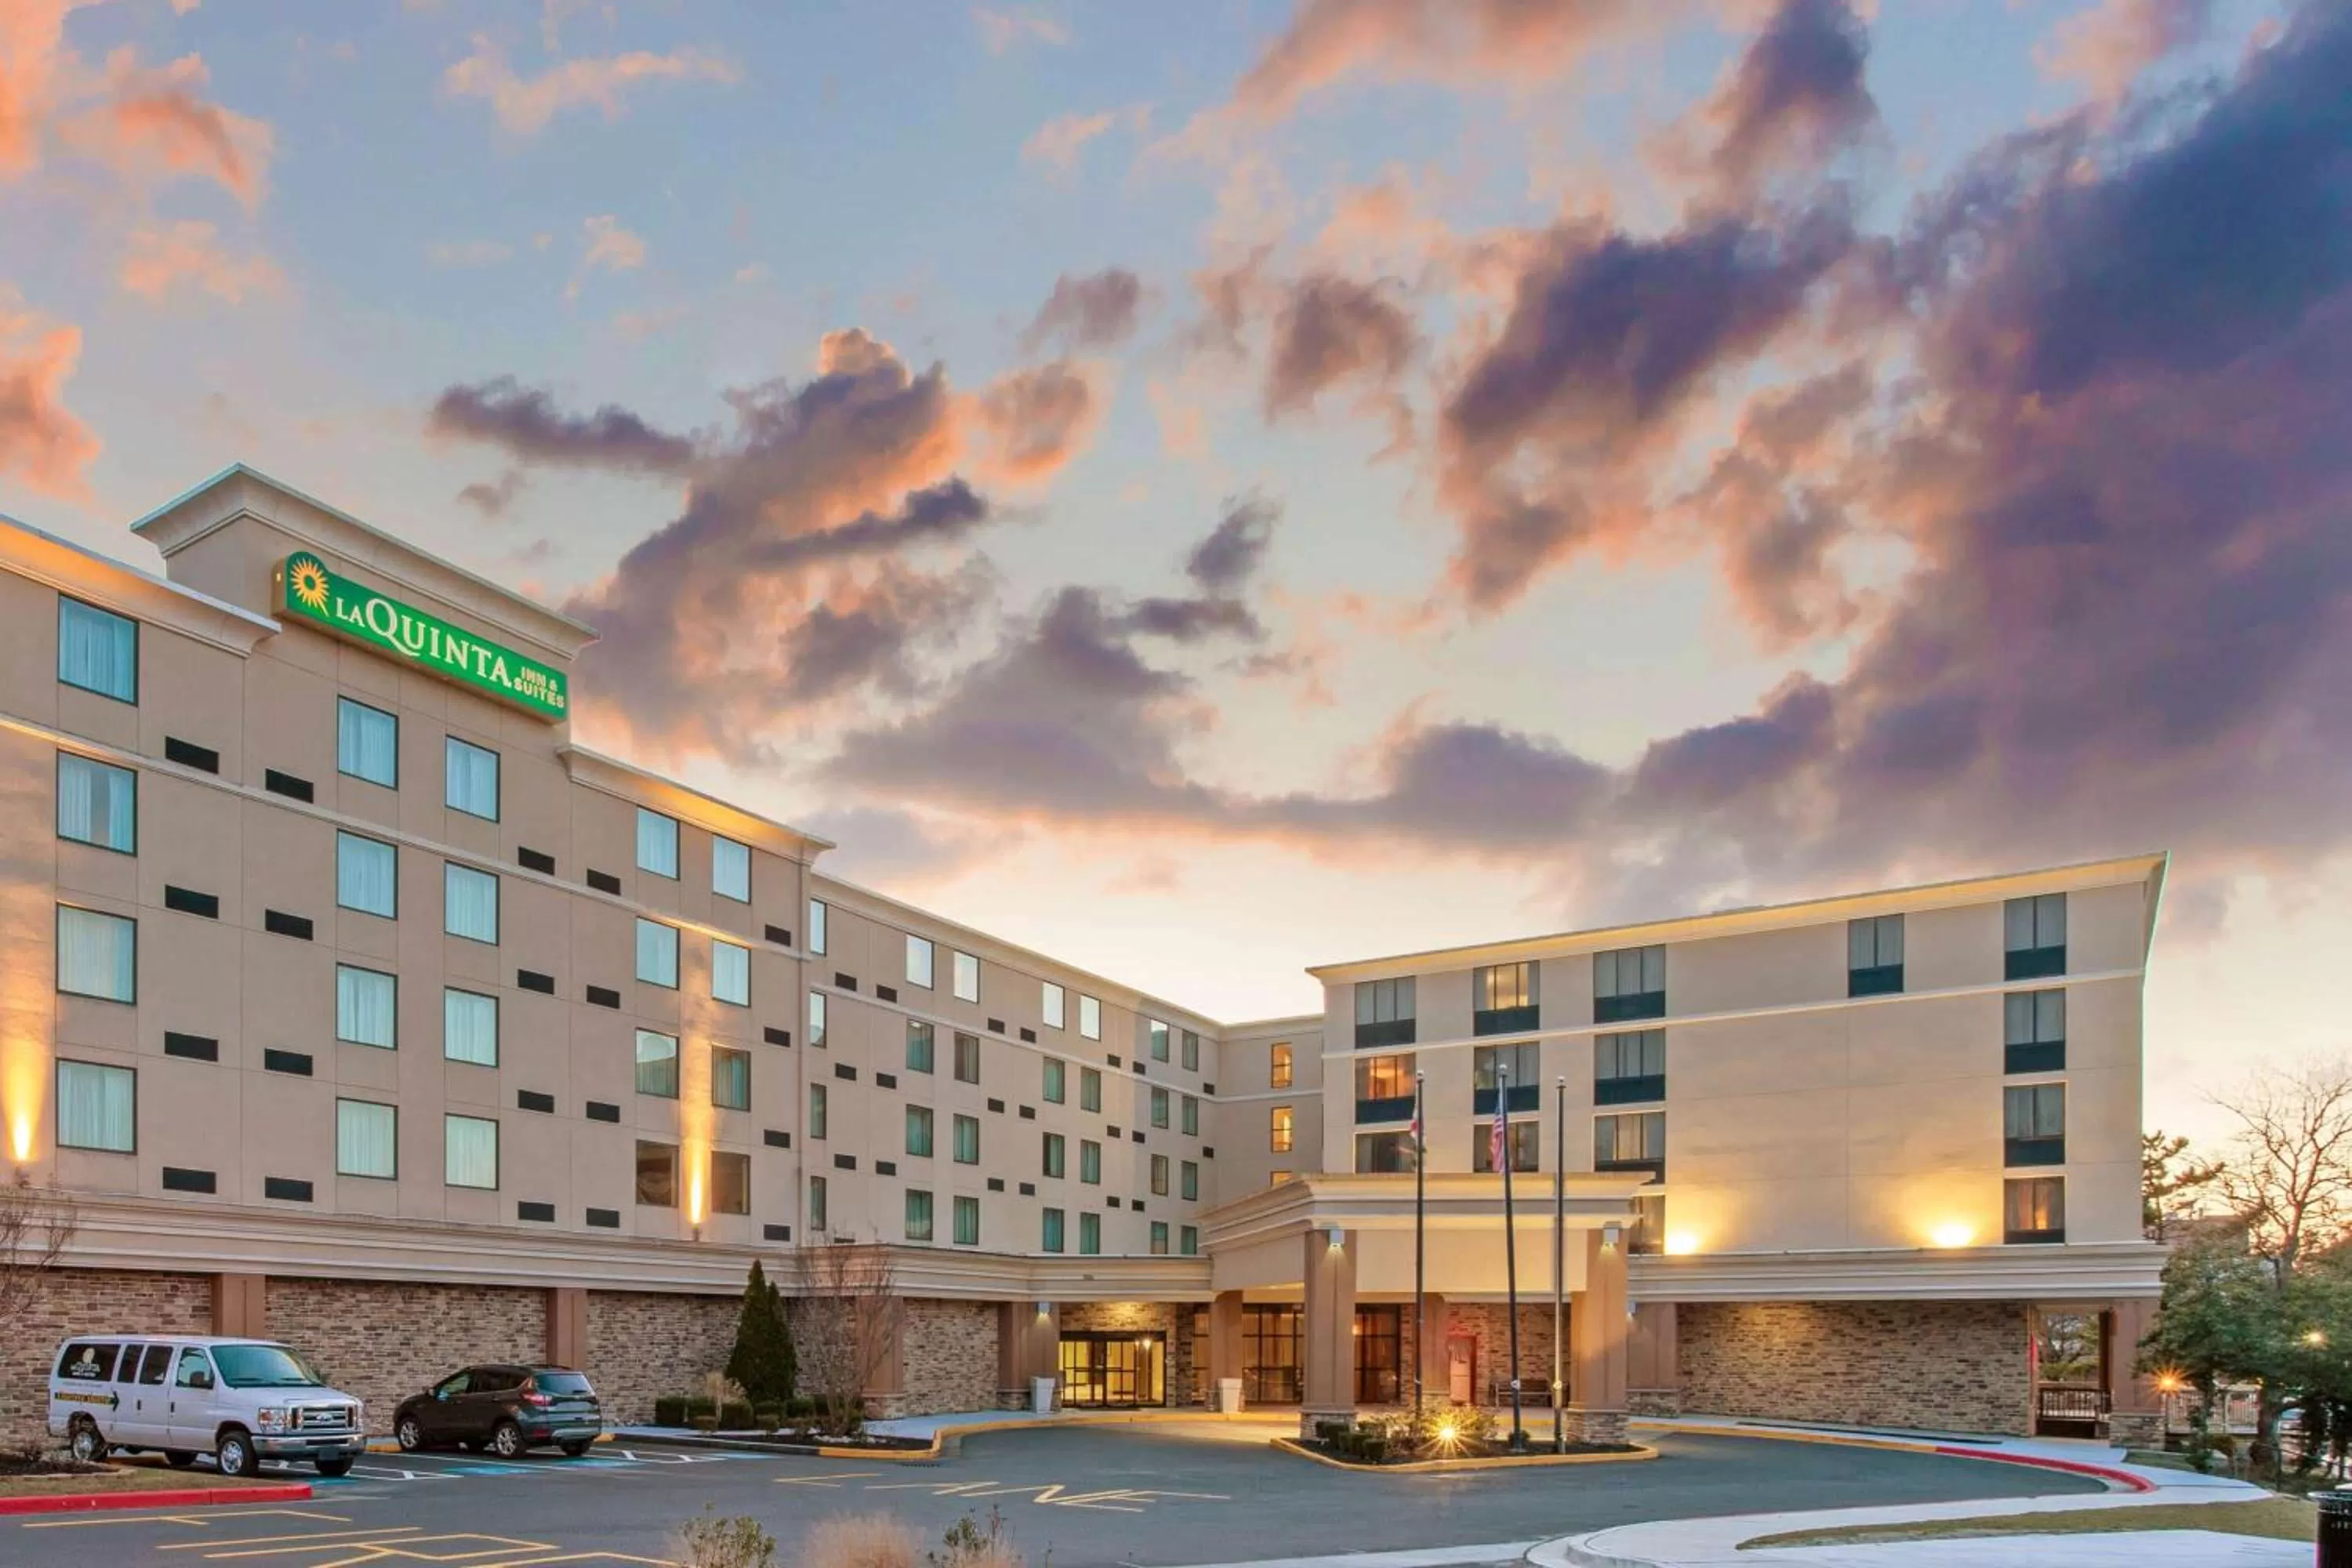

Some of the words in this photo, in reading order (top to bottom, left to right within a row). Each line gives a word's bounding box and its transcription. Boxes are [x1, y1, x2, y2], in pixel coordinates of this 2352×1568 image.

[336, 597, 365, 628] LA
[365, 598, 512, 688] QUINTA
[514, 677, 564, 708] SUITES
[521, 666, 546, 688] INN
[549, 678, 558, 692] &
